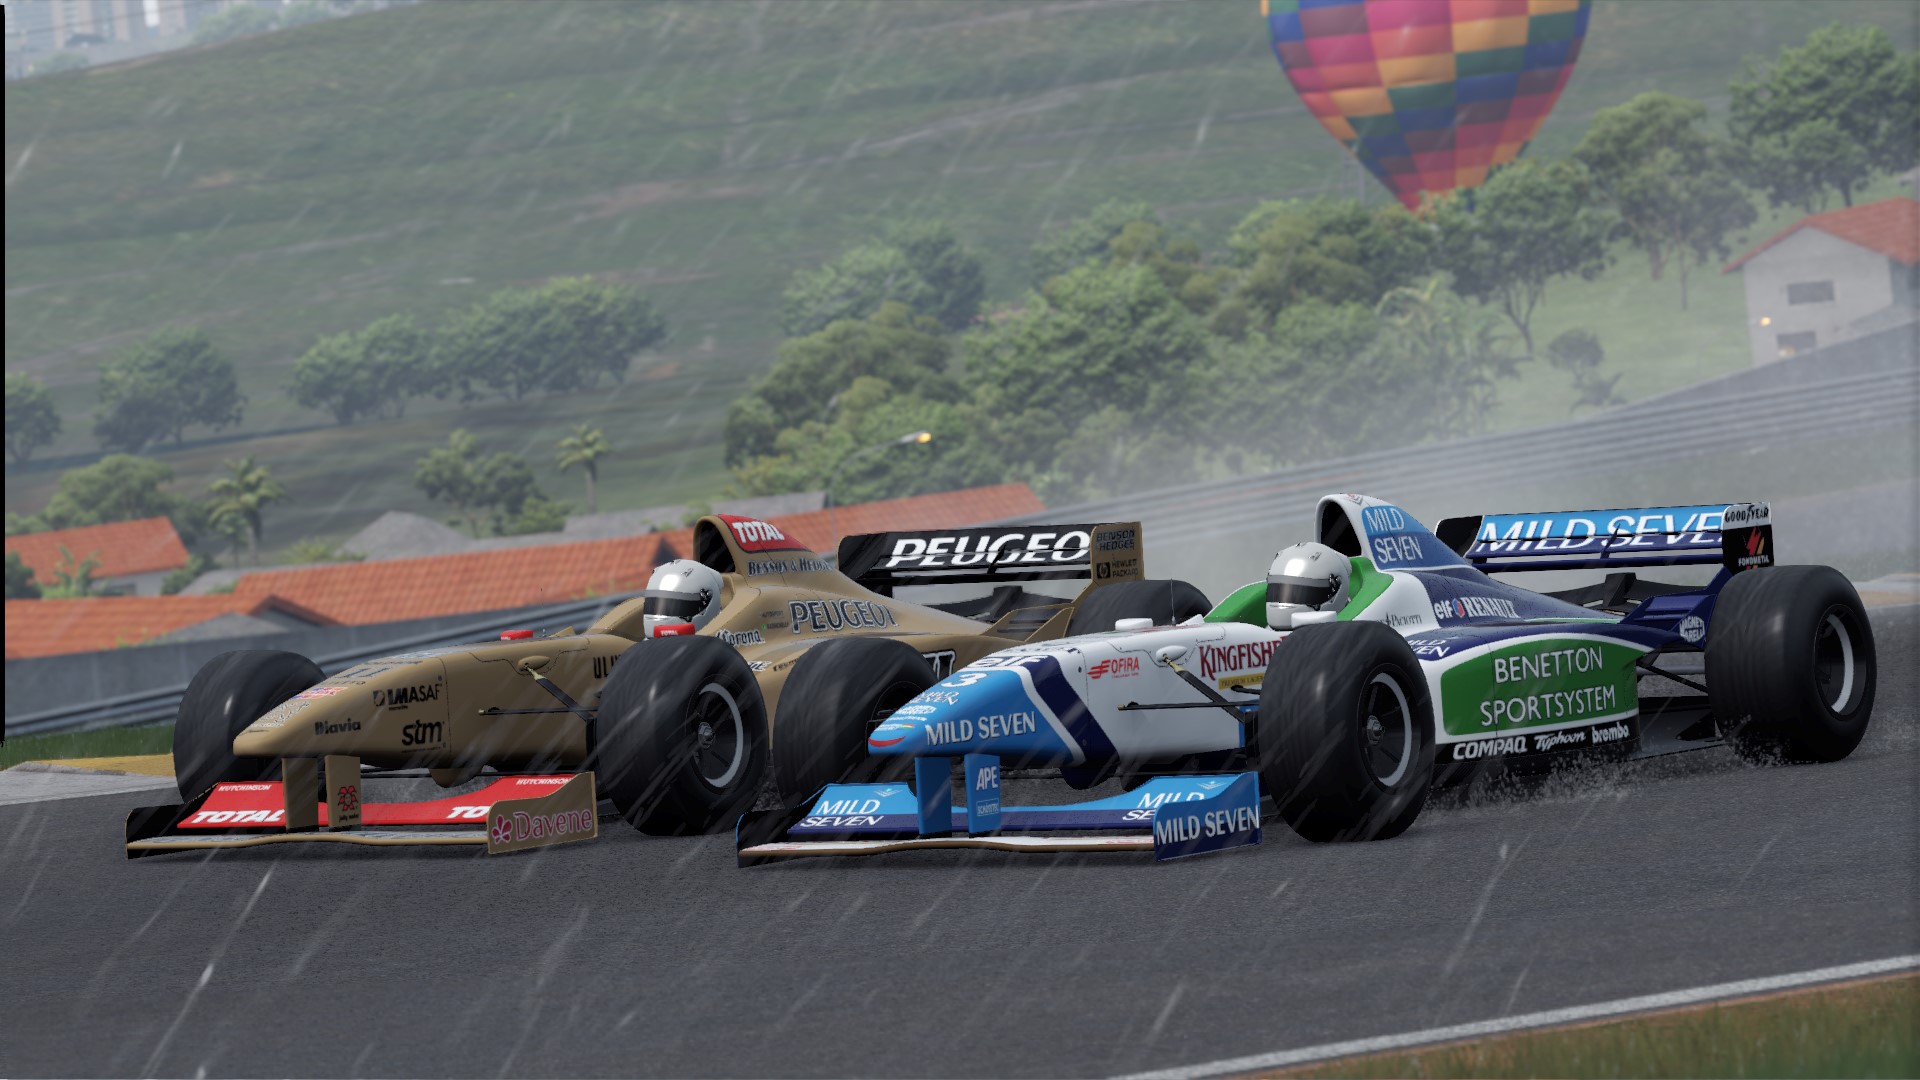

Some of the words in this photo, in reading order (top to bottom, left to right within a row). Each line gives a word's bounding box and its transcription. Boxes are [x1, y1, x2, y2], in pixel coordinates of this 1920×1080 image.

[1365, 507, 1405, 533] MILD
[1725, 505, 1769, 524] GOODYEAR
[732, 521, 785, 543] TOTAL
[1476, 517, 1597, 553] MILD
[1600, 511, 1723, 548] SEVE
[885, 530, 1091, 568] PEUGEO
[1374, 535, 1424, 564] SEVEN
[788, 599, 899, 635] PEUGEOT
[1434, 600, 1453, 620] elf
[1460, 597, 1521, 619] RENAULT
[1111, 656, 1140, 674] OFIRA
[1199, 636, 1288, 681] KINGFISH
[1494, 646, 1603, 684] BENETTON
[941, 672, 987, 688] 3
[1480, 684, 1616, 726] SPORTSYSTEM
[315, 717, 362, 736] Diavia
[924, 718, 974, 746] MILD
[978, 710, 1037, 740] SEVEN
[1592, 721, 1629, 746] brembo
[1453, 735, 1528, 761] COMPAQ
[218, 784, 272, 793] HUTCHINSON
[516, 777, 573, 786] HUTCHINSON
[976, 765, 999, 791] APE
[191, 809, 286, 825] TOTAL
[815, 799, 881, 816] MILD
[513, 808, 593, 842] Davene
[800, 815, 884, 828] SEVEN
[1155, 815, 1201, 846] MILD
[1204, 804, 1260, 838] SEVEN
